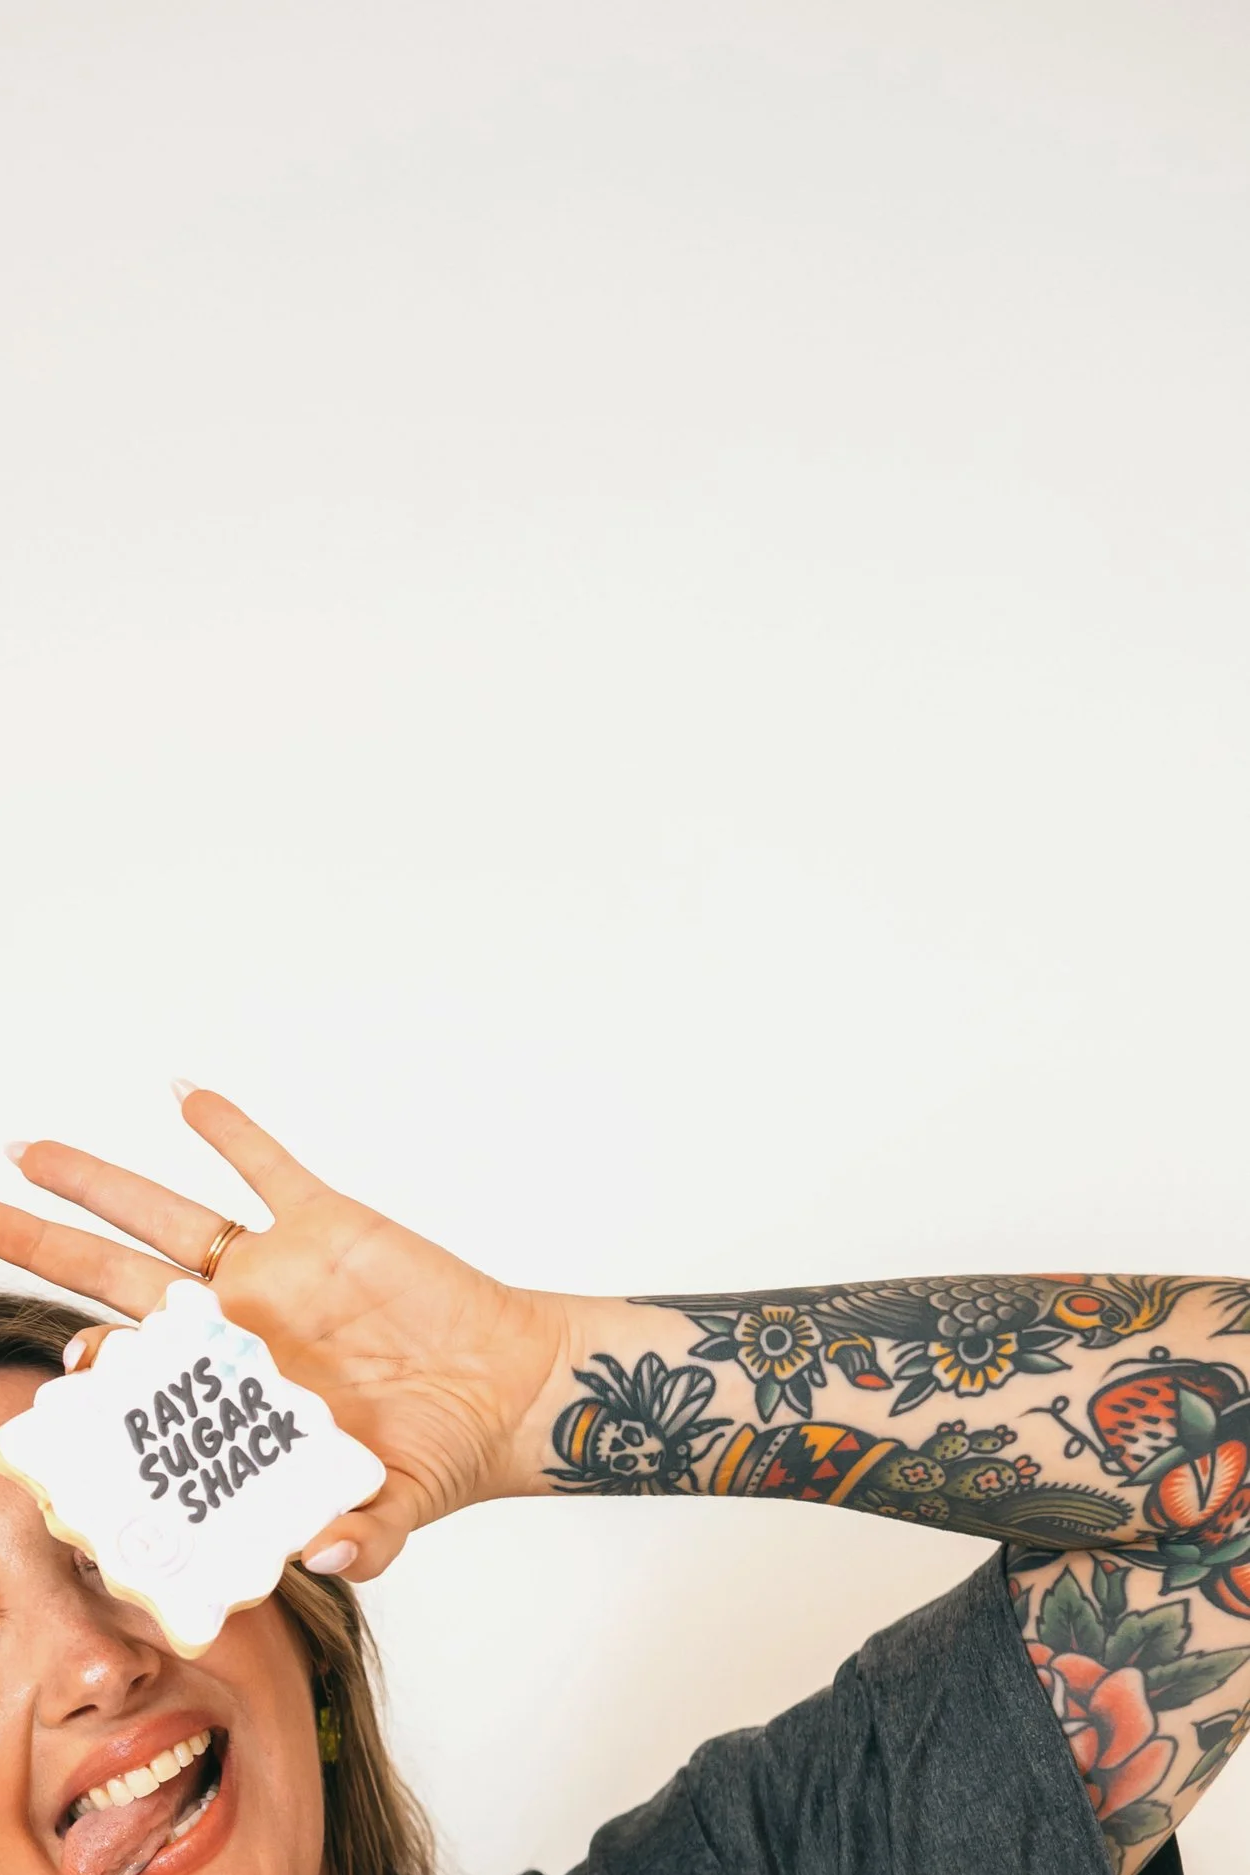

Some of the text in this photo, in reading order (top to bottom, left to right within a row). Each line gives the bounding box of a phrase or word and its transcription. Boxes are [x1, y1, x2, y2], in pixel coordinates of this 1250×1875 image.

[124, 1356, 222, 1455] RAYS
[139, 1377, 272, 1499] SUGAR
[178, 1410, 308, 1524] SHACK
